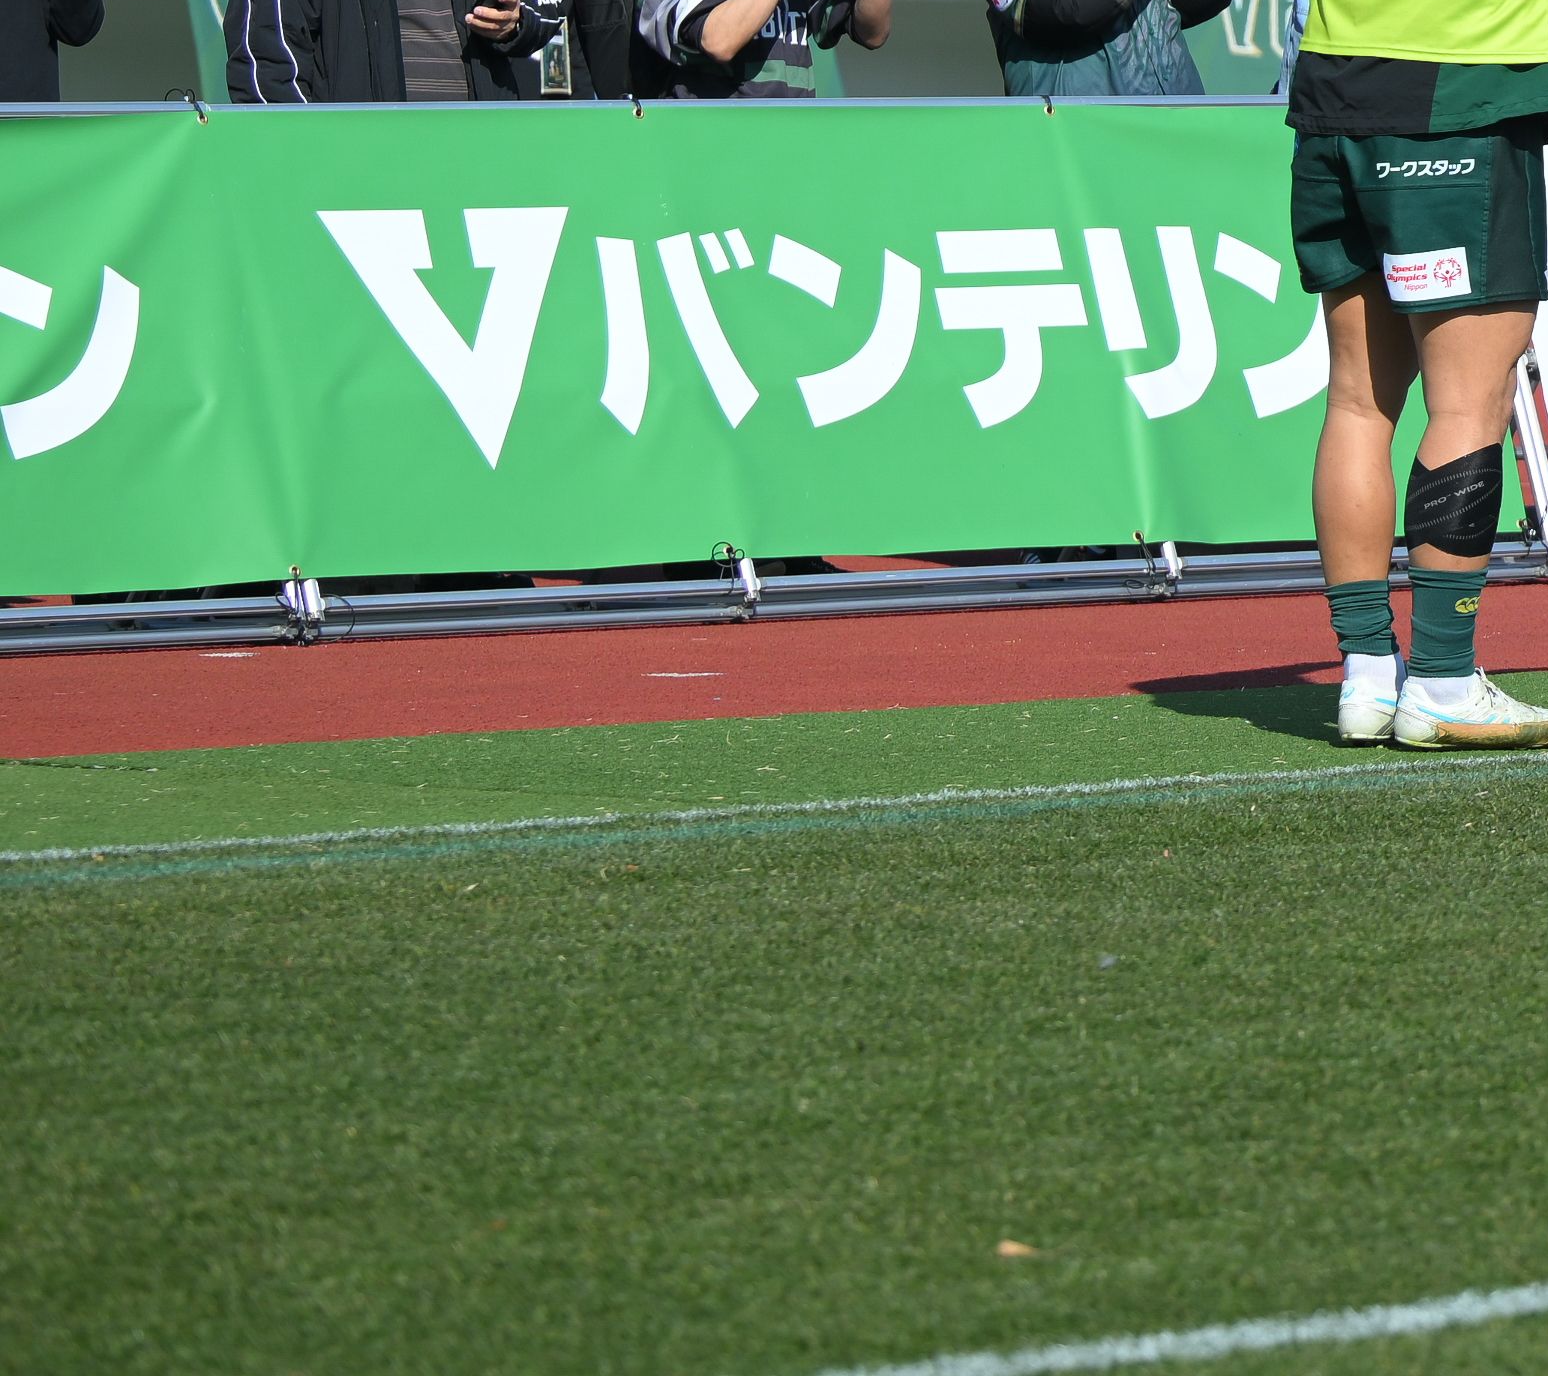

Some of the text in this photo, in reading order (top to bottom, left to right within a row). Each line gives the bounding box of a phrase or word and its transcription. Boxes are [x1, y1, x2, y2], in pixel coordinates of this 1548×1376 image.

[1376, 158, 1476, 179] ワークスタッフ
[1391, 263, 1427, 274] Special
[1386, 273, 1428, 283] Olympics
[1404, 283, 1428, 291] Nippon
[1454, 480, 1486, 498] WIDE
